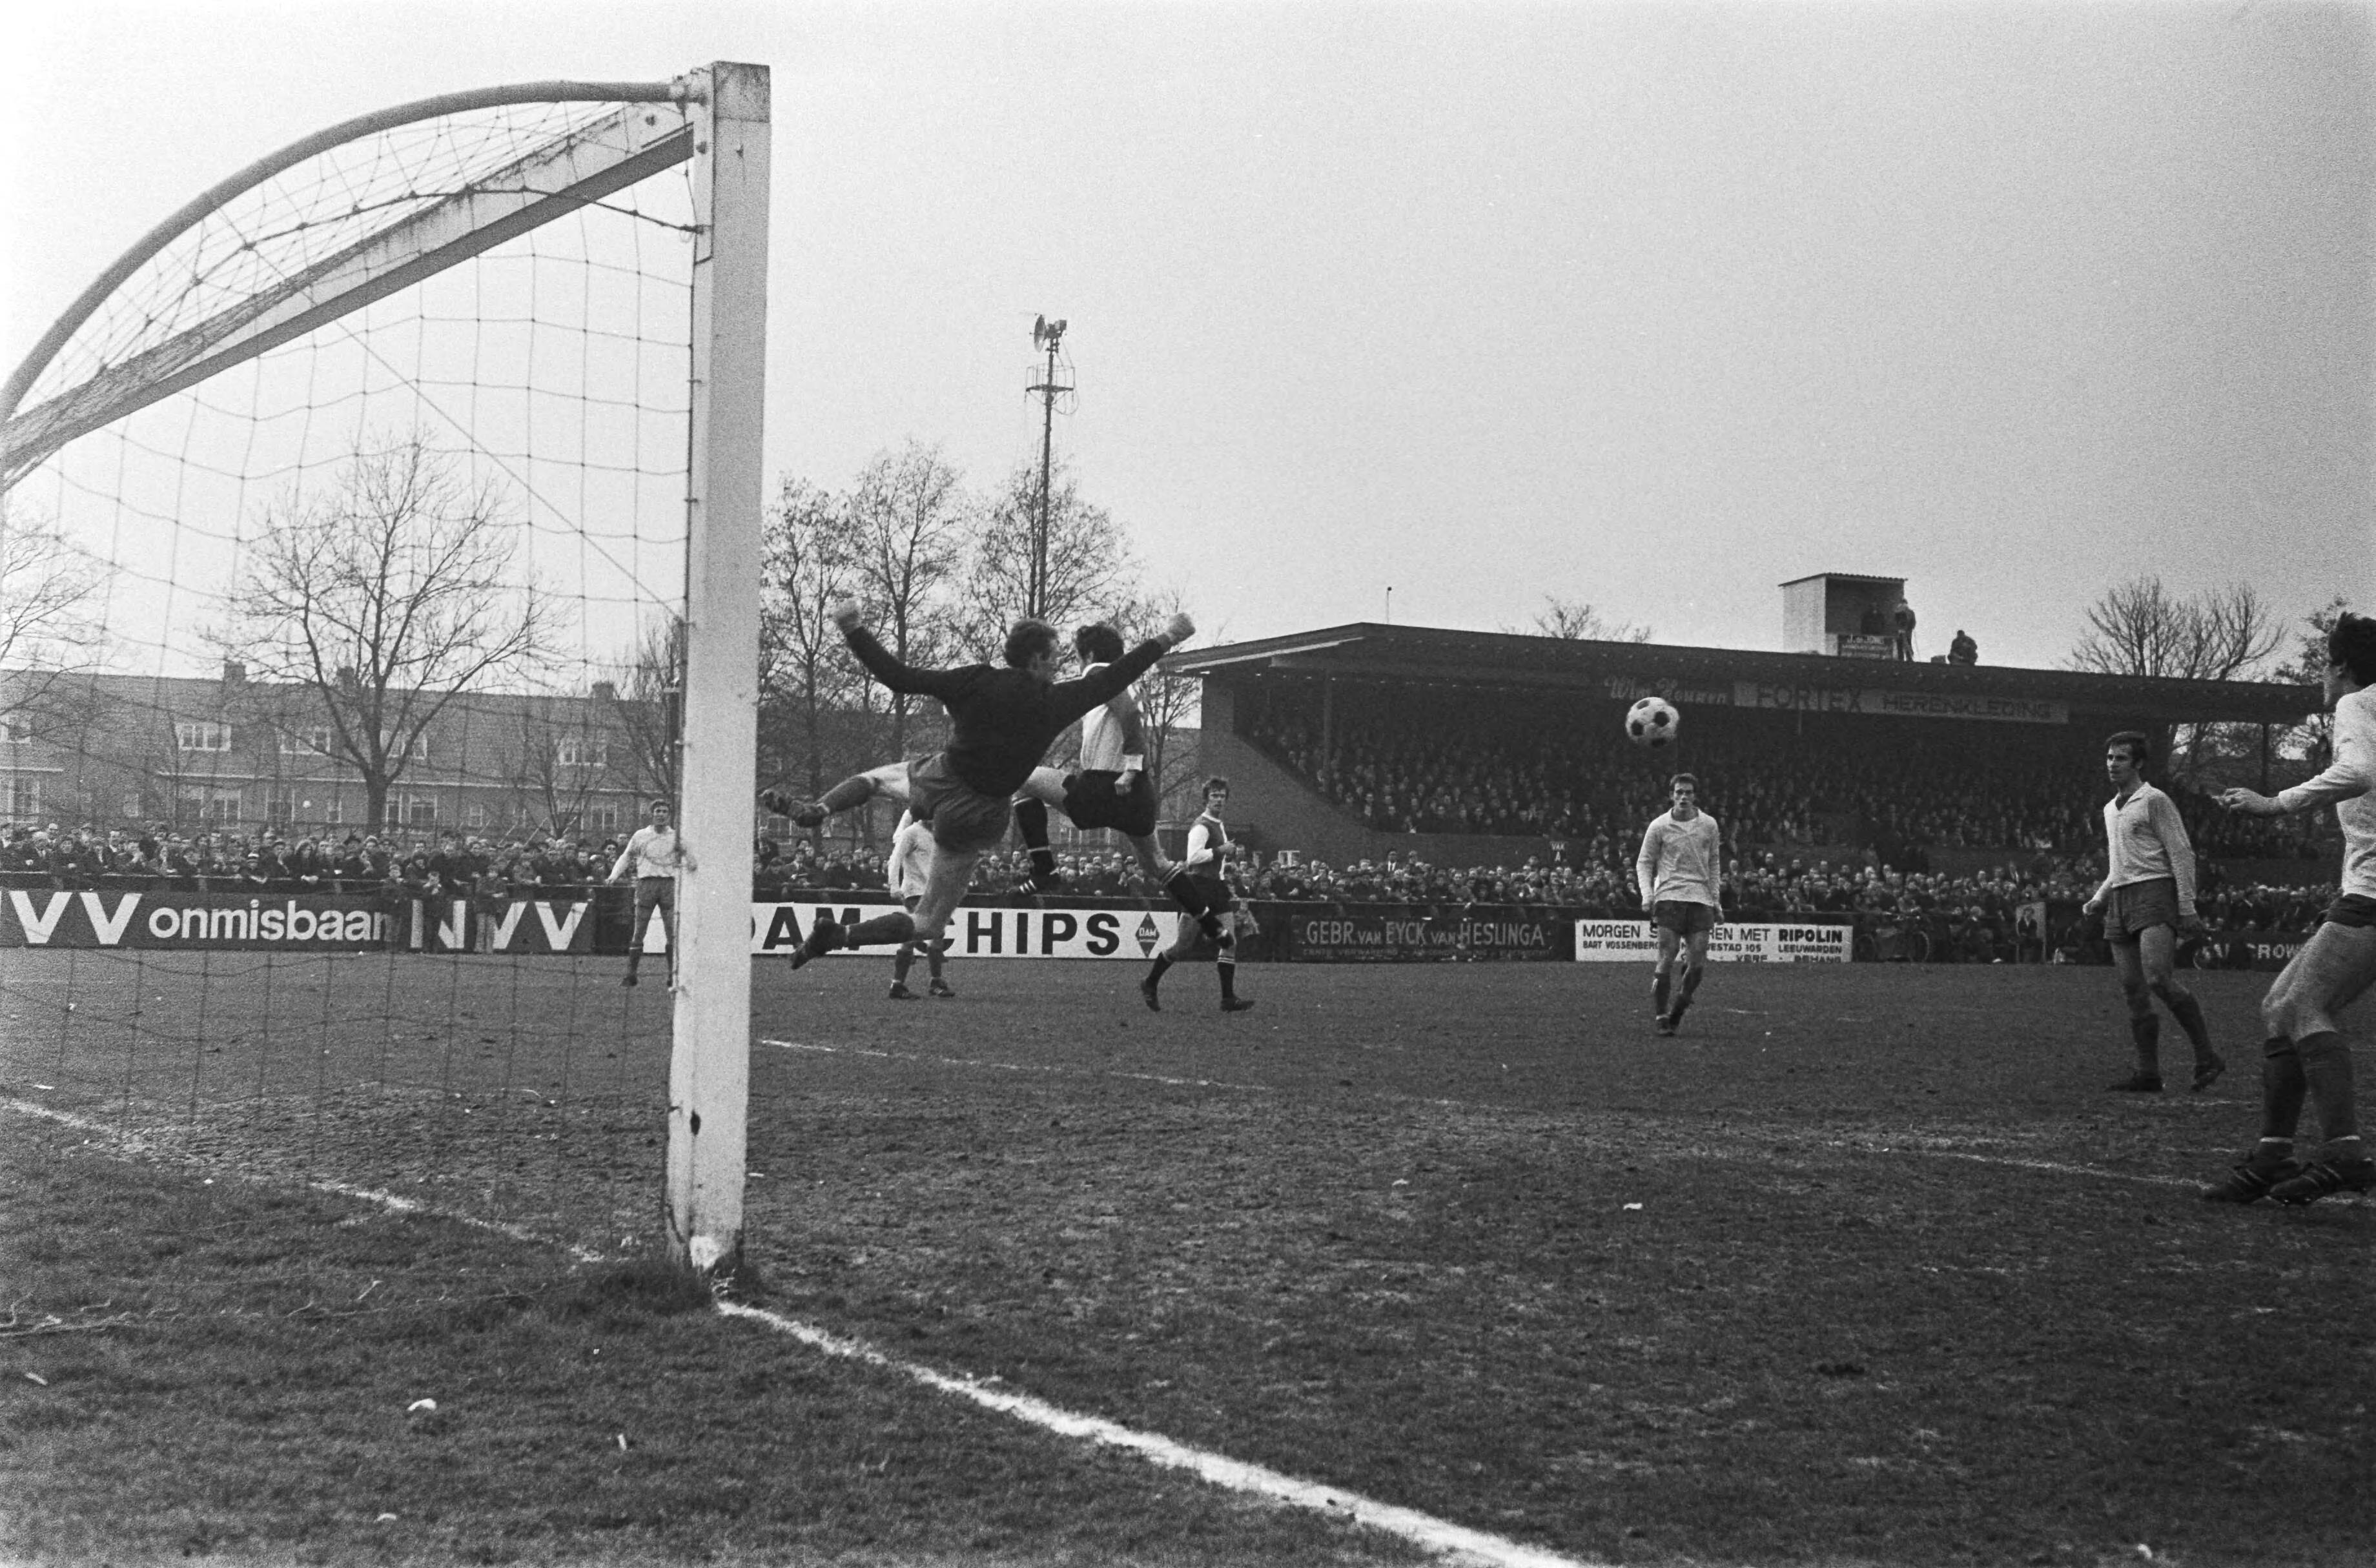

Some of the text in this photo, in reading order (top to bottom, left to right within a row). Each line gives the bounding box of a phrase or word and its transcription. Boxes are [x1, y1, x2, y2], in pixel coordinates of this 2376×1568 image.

[1882, 693, 2051, 718] HERENKLEDING
[0, 891, 143, 944] VV
[148, 899, 389, 941] onmisbaar
[1139, 927, 1157, 937] DAM
[1358, 931, 1382, 944] VAN
[1386, 921, 1427, 945] EYCK
[1431, 932, 1456, 945] VAN
[1460, 922, 1544, 946] HESLINGA
[1582, 924, 1641, 938] MORGEN
[1741, 928, 1770, 942] MET
[1779, 929, 1843, 942] RIPOLIN
[1778, 944, 1842, 953] LEEUWARDEN
